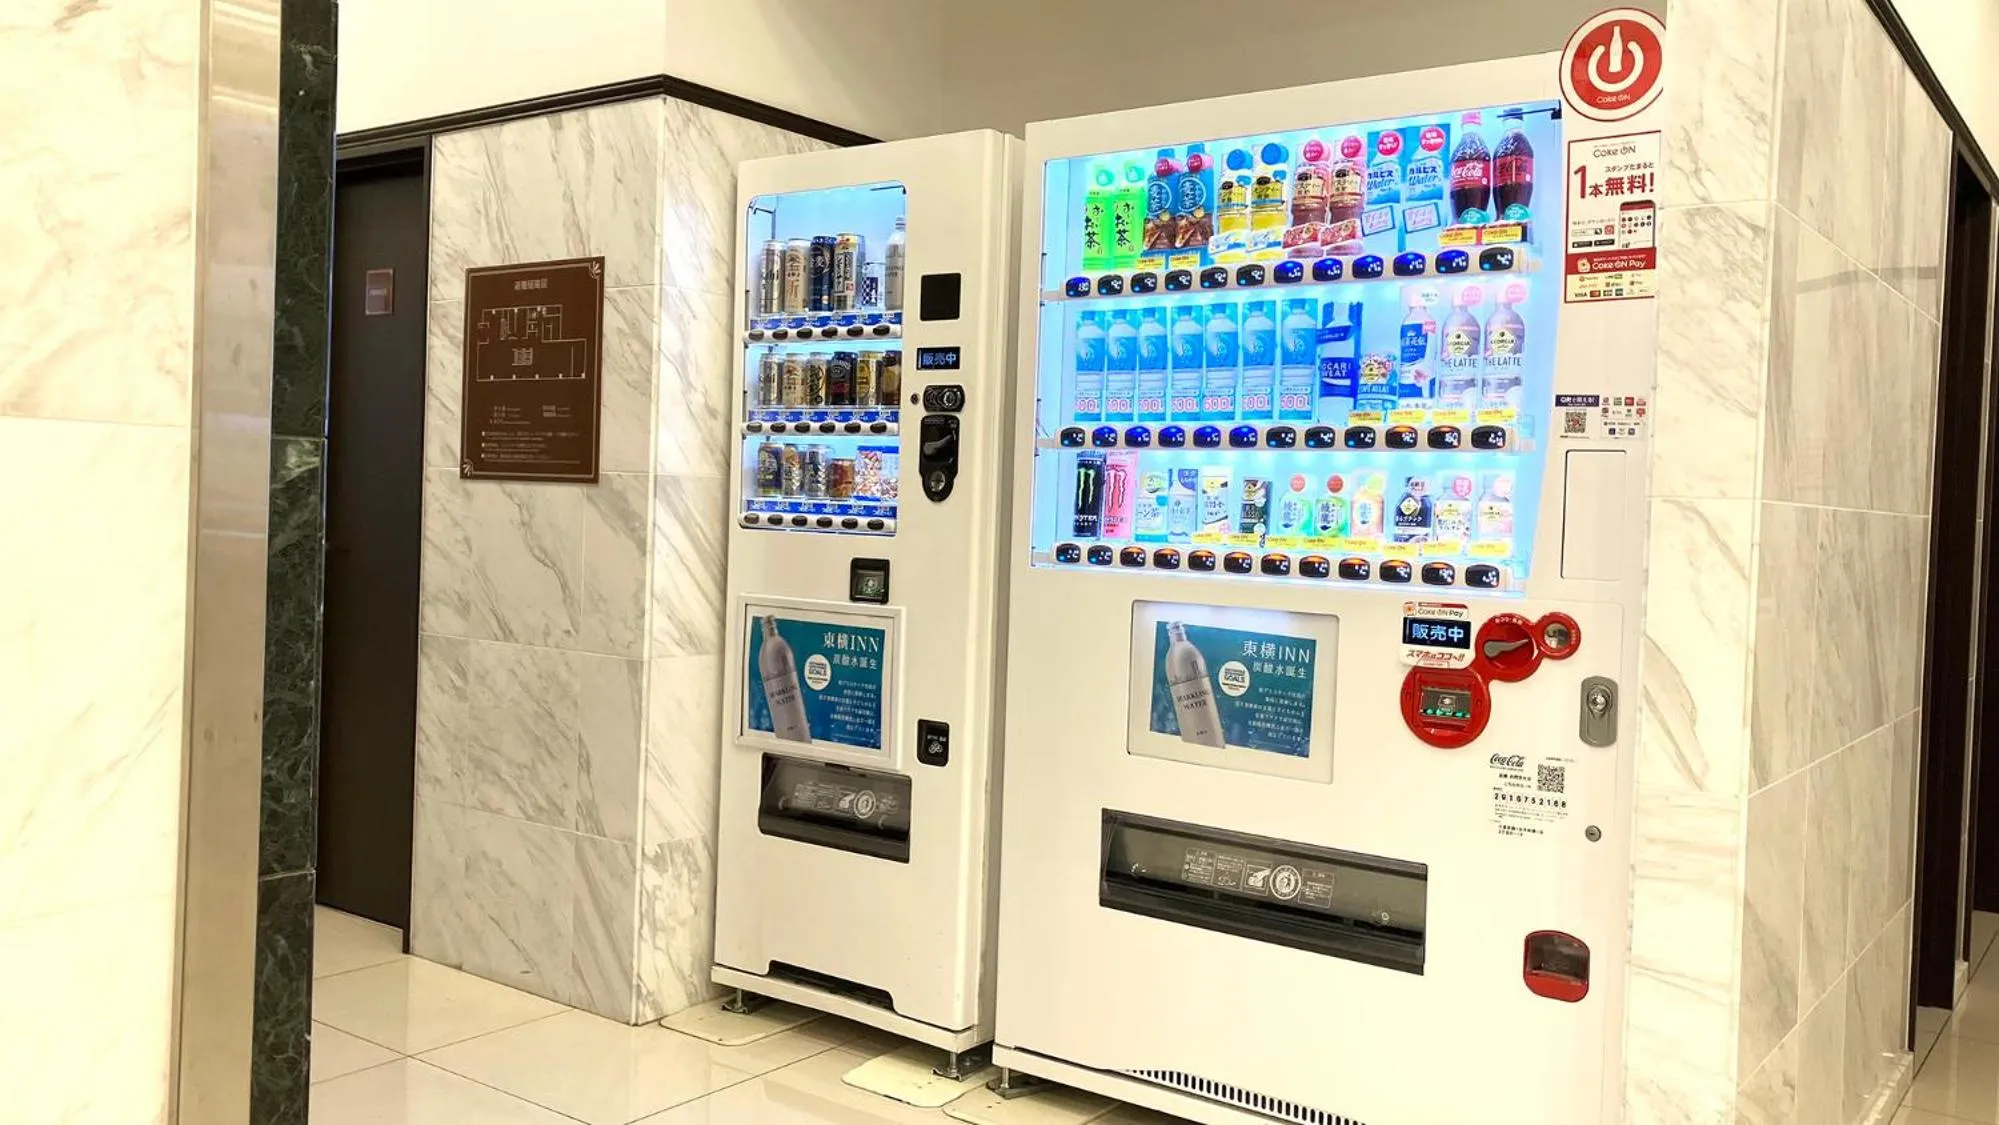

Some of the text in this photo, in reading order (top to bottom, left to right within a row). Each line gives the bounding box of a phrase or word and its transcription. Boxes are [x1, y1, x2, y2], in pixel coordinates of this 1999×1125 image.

[1593, 148, 1618, 158] Coke
[1604, 162, 1655, 173] スタンプたまると
[1592, 262, 1614, 270] Coke
[1629, 259, 1647, 269] Pay
[922, 352, 957, 366] 販売中
[1411, 623, 1465, 643] 販売中
[823, 631, 880, 652] 東横INN
[1241, 640, 1310, 663] 東横INN
[1252, 663, 1308, 679] 炭酸水誕生
